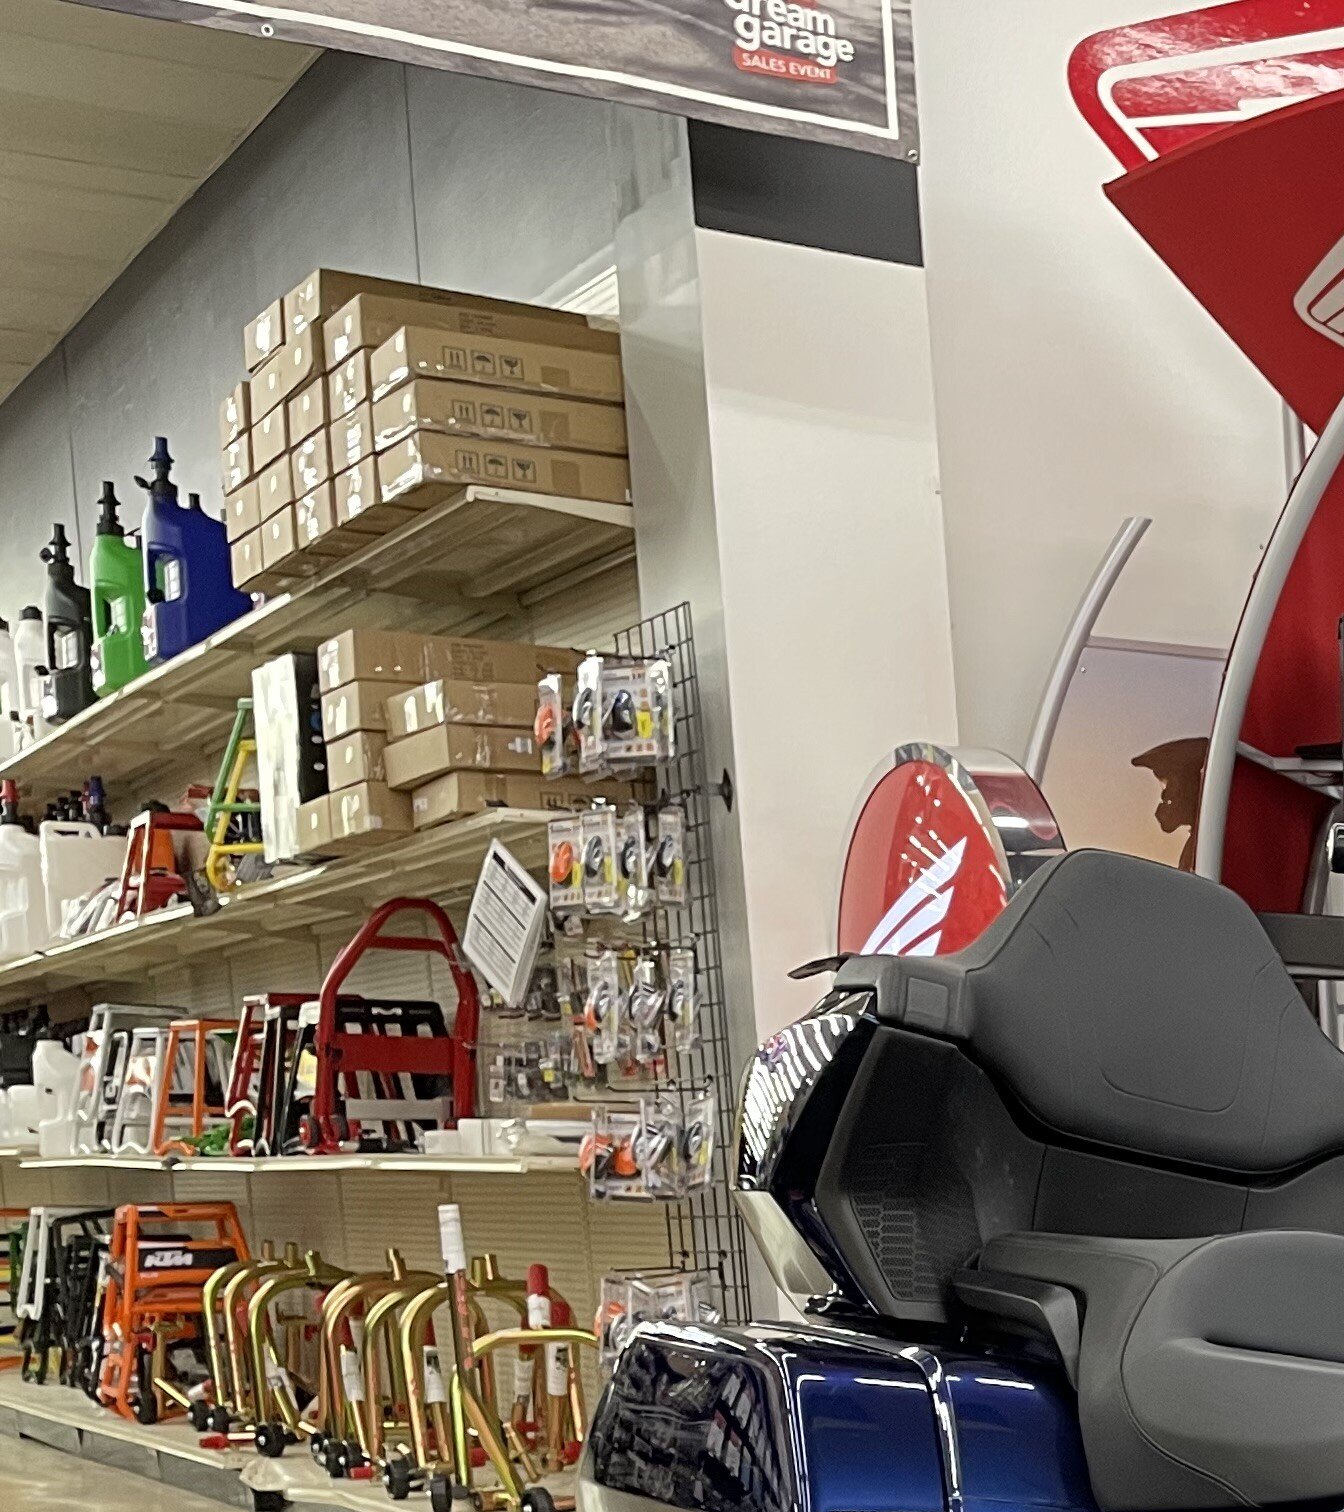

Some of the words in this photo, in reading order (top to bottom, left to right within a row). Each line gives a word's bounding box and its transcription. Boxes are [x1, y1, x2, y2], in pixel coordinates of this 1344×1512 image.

[733, 13, 855, 67] garage
[742, 52, 787, 74] SALES
[788, 62, 831, 80] EVENT
[143, 1250, 194, 1268] KTM
